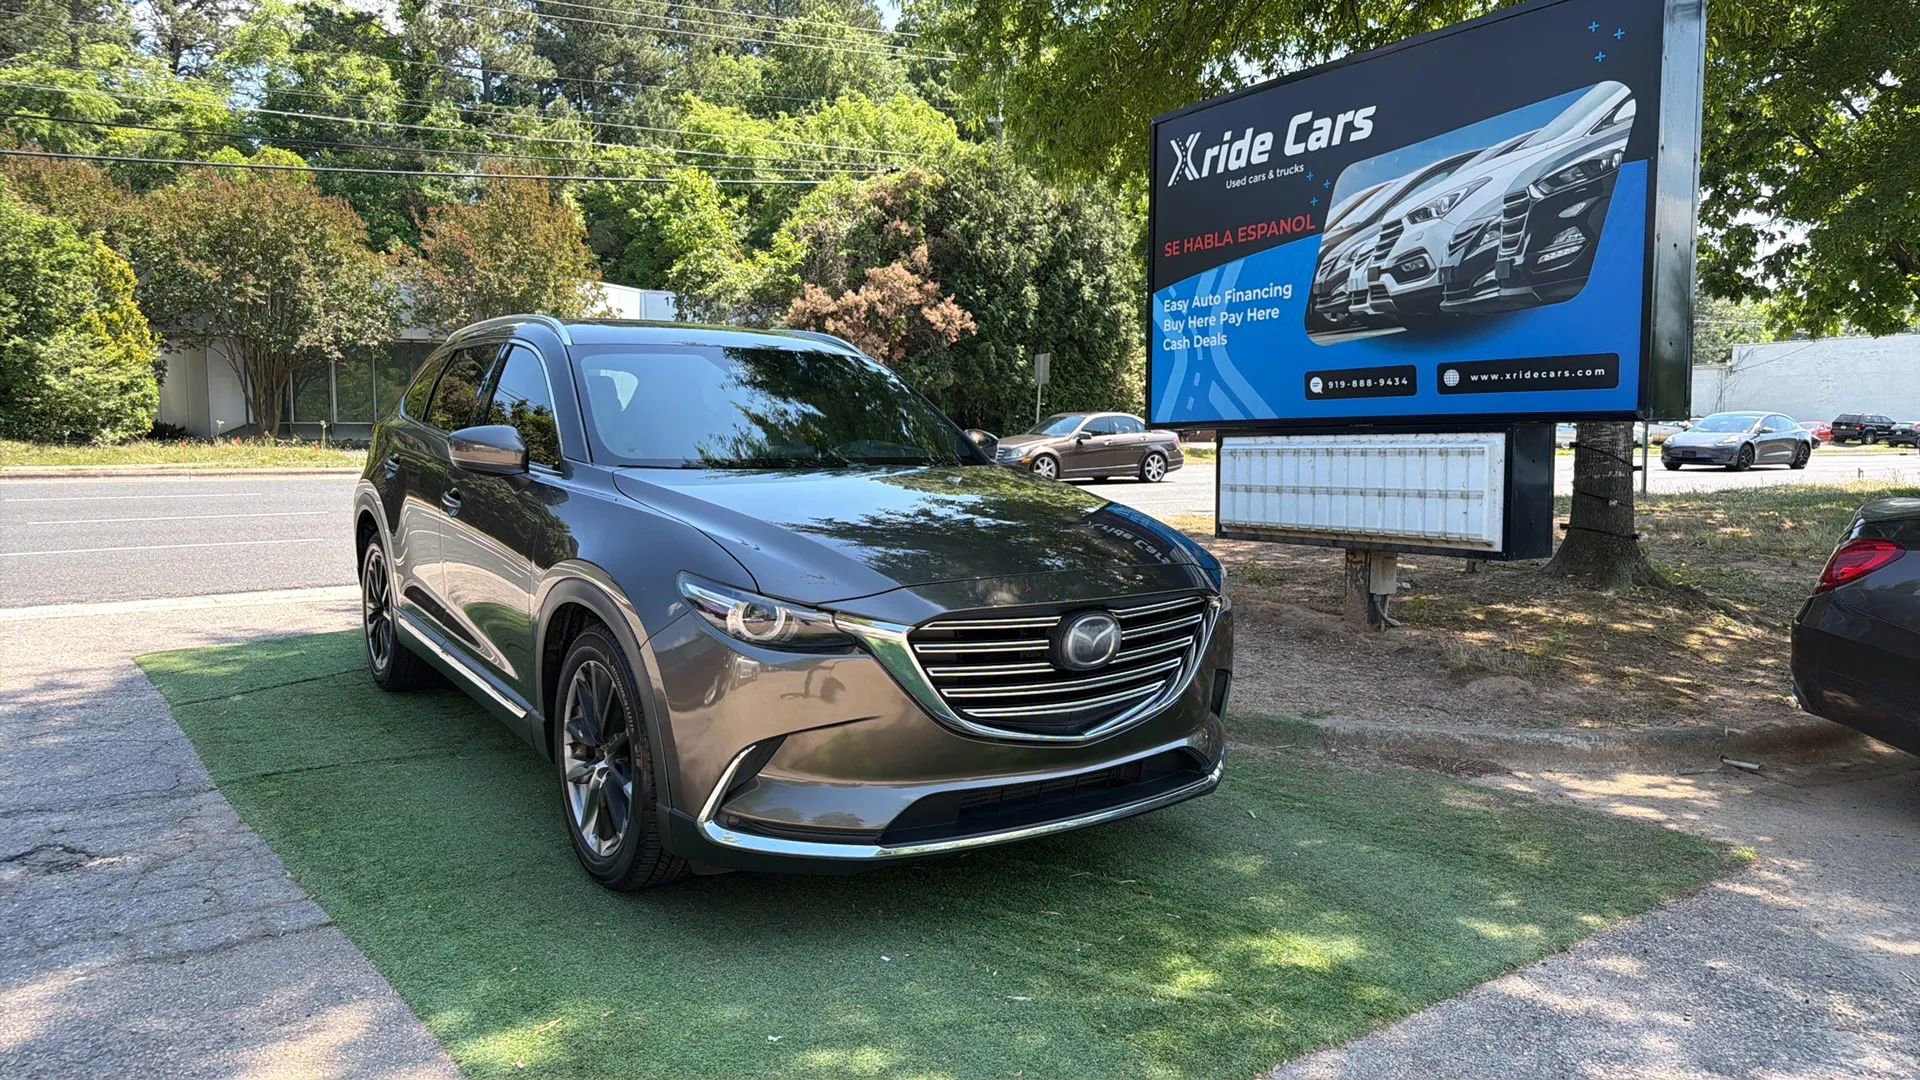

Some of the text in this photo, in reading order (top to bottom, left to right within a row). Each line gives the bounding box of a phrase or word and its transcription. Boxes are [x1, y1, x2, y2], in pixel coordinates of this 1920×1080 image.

[1284, 105, 1377, 157] Cars
[1226, 162, 1304, 189] Used cars & trucks
[1164, 214, 1316, 257] SE HABLA ESPANOL
[1164, 282, 1293, 313] Easy Auto Financing
[1163, 305, 1280, 334] Buy Here Pay Here
[1163, 332, 1228, 351] Cash Deals
[1327, 377, 1409, 390] 919-888-9434
[1470, 366, 1606, 381] www.xridecars.com
